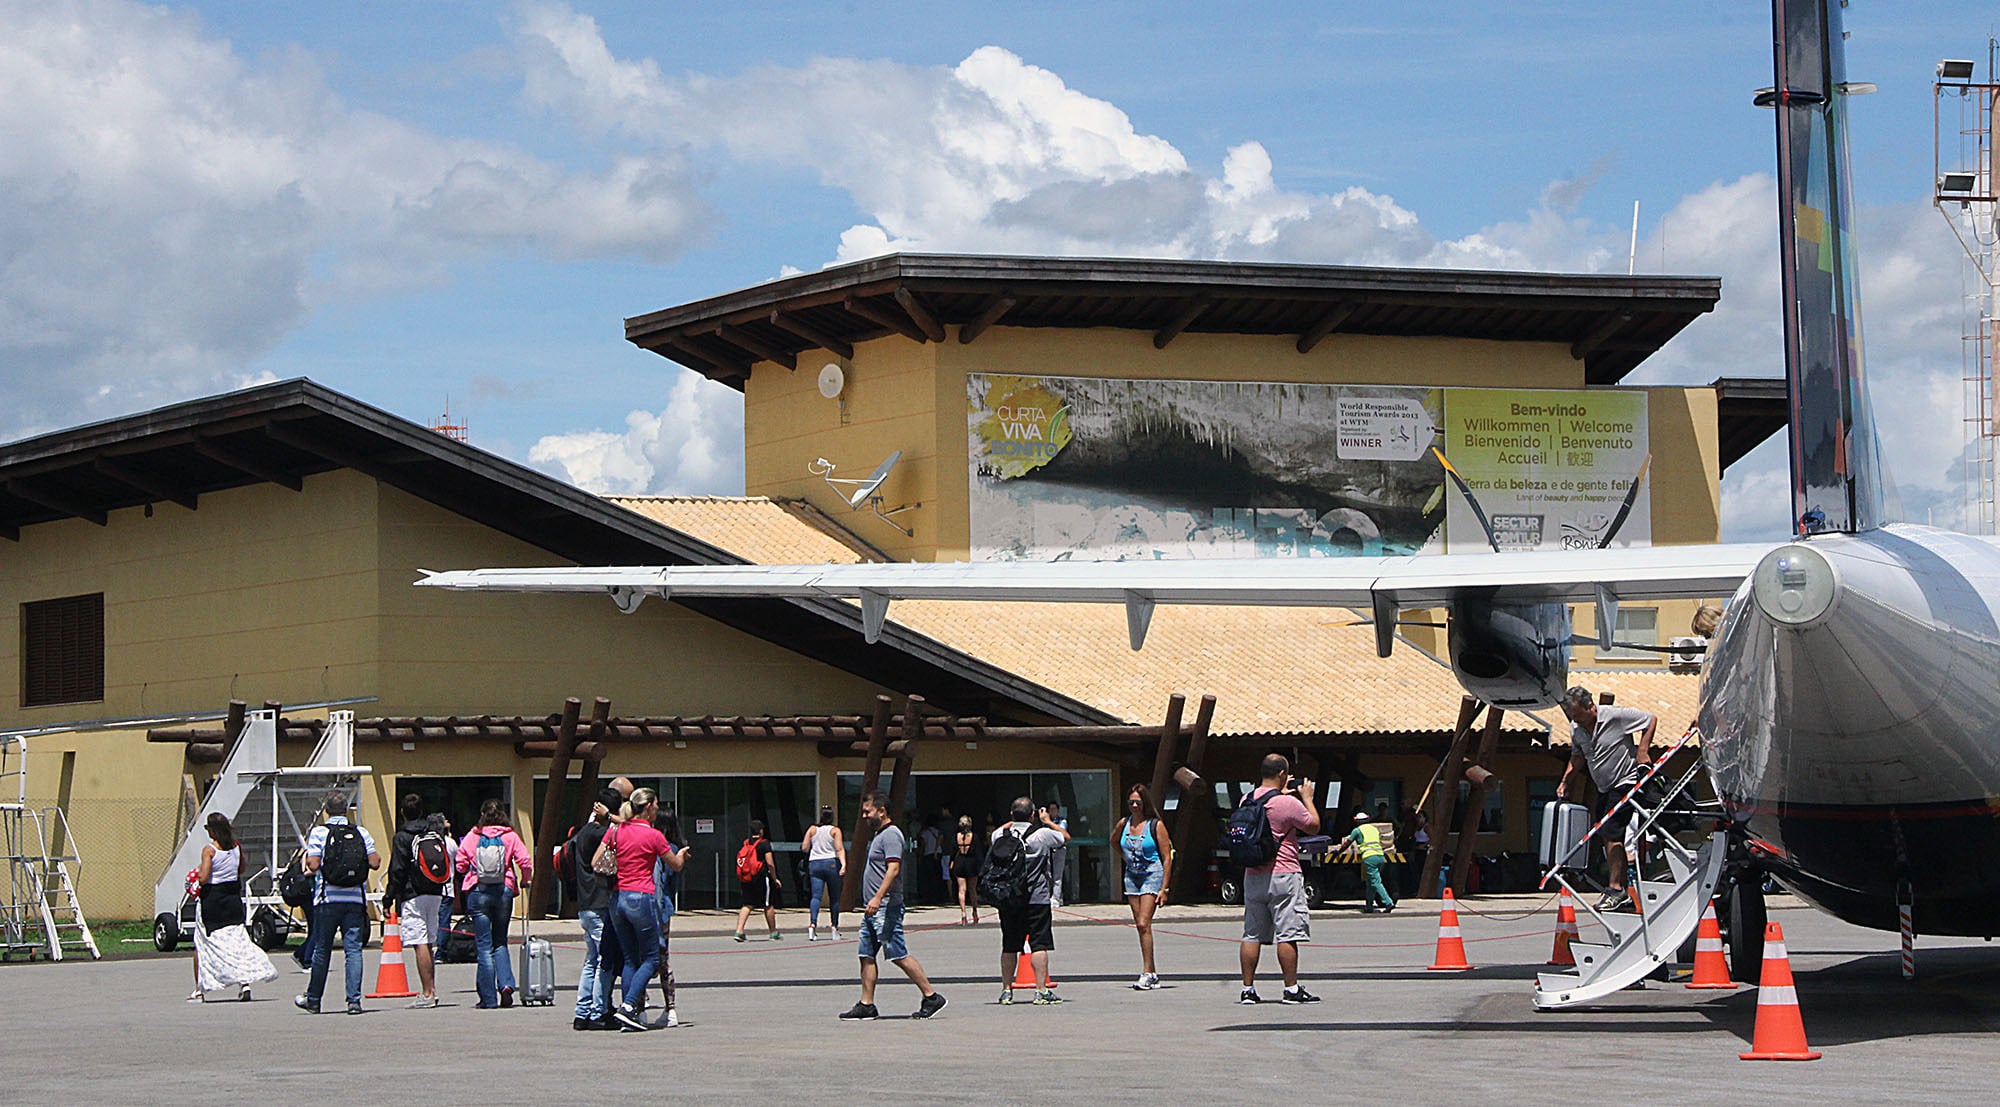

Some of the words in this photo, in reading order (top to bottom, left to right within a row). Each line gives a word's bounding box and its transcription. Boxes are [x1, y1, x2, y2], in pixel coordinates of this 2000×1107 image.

[997, 405, 1047, 422] CURTA
[1340, 403, 1363, 411] World
[1365, 403, 1408, 412] Responsible
[1340, 410, 1371, 418] Tourism
[1511, 403, 1587, 416] Bem-vindo
[1001, 422, 1042, 440] VIVA
[1464, 418, 1550, 433] Willkommen
[1570, 420, 1633, 433] Welcome
[991, 440, 1058, 457] BONITO
[1340, 438, 1382, 448] WINNER
[1464, 435, 1541, 448] Bienvenido
[1561, 436, 1633, 449] Benvenuto
[1497, 452, 1548, 465] Accueil
[1463, 478, 1490, 489] Terra
[1494, 478, 1508, 489] da
[1510, 479, 1547, 490] beleza
[1551, 481, 1558, 490] e
[1560, 480, 1574, 490] de
[1577, 480, 1608, 493] gente
[1611, 480, 1633, 490] feli
[1584, 494, 1607, 503] happy
[1493, 517, 1540, 529] SECTUR
